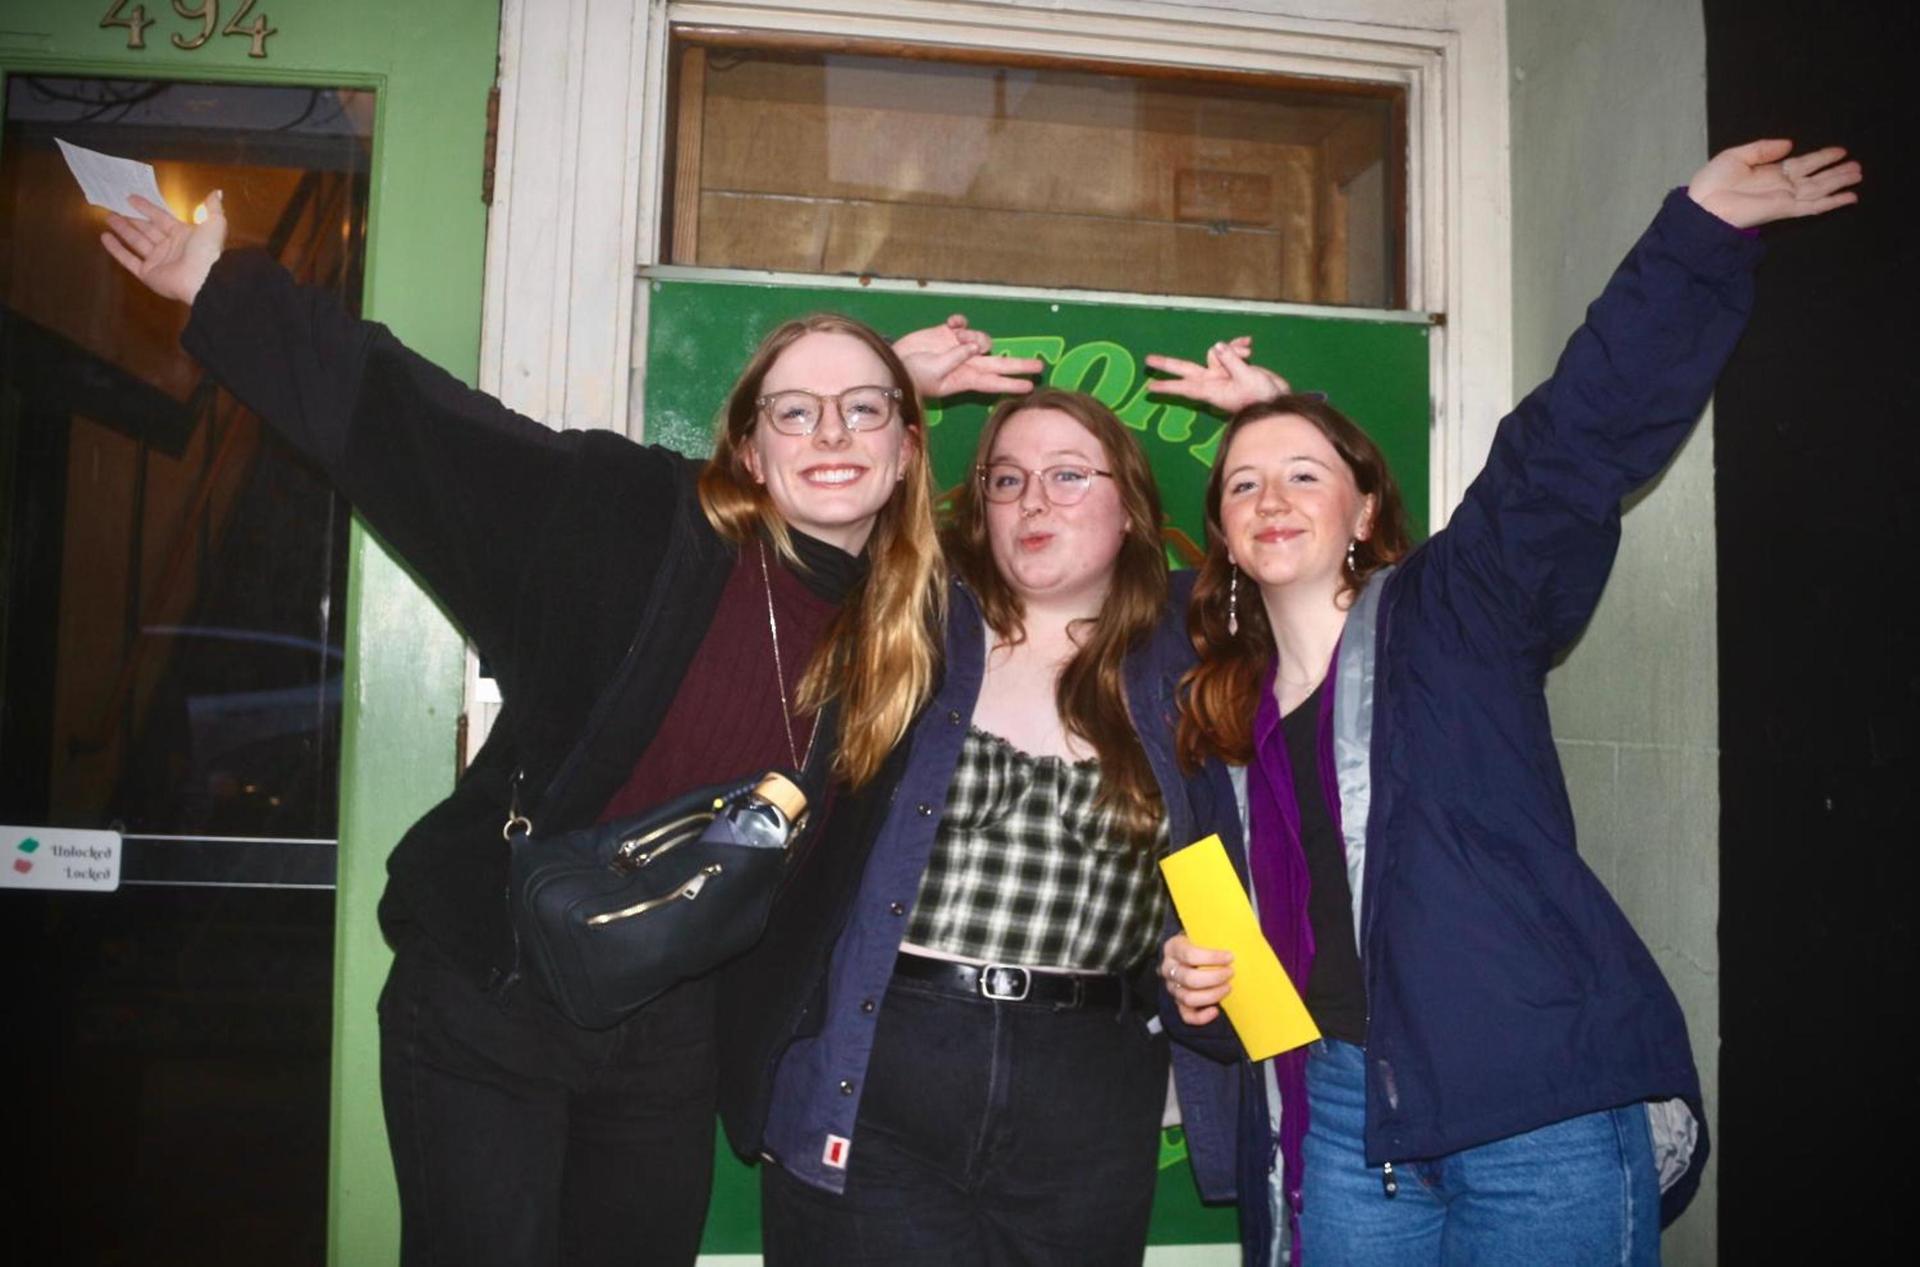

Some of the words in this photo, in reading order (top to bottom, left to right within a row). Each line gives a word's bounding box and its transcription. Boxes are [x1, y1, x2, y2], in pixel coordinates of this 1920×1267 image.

[99, 0, 277, 58] 494
[50, 845, 112, 860] Unlocked
[64, 866, 111, 881] Locked
